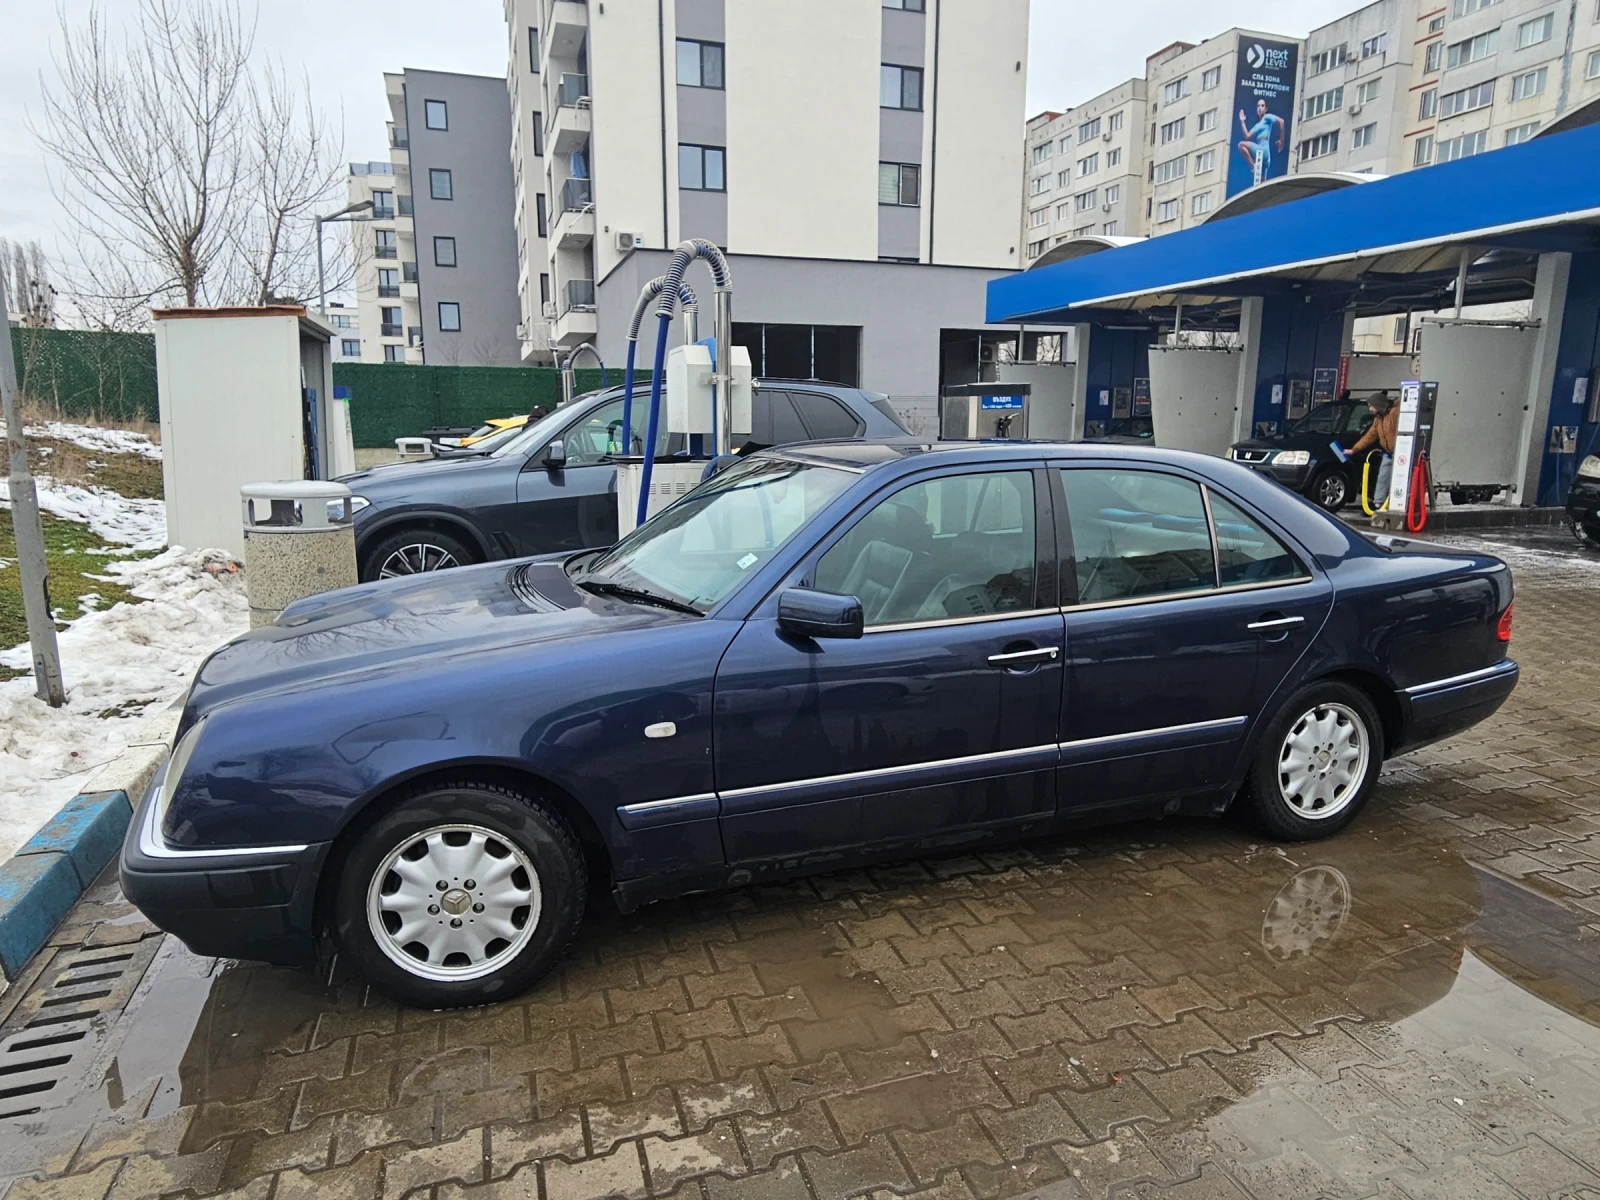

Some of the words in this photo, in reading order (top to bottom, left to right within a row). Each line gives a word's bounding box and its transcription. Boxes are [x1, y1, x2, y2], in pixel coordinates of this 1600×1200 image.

[1265, 49, 1289, 61] next
[1265, 58, 1288, 69] LEVEL
[1252, 73, 1265, 81] СПА
[1265, 75, 1281, 83] ЗОНА
[1241, 79, 1256, 87] ЗАЛА
[1264, 83, 1290, 92] ГРУПОВИ
[1253, 88, 1277, 98] ФИТНЕС
